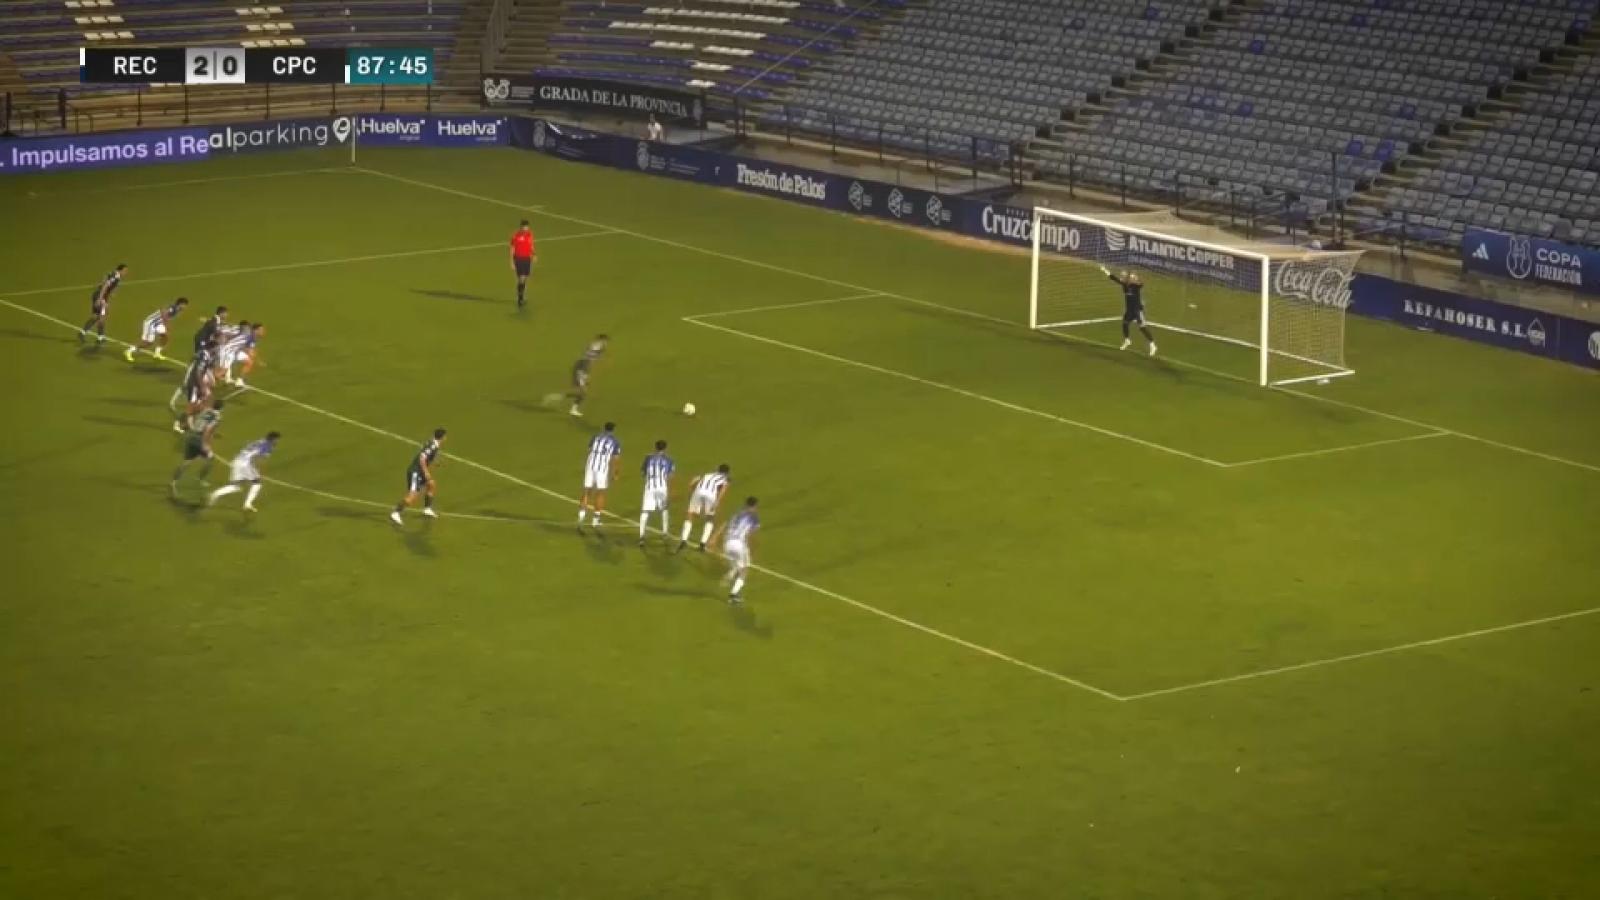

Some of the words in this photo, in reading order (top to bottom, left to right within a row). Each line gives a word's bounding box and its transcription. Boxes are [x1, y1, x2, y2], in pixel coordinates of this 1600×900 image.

[539, 85, 589, 104] GRADA
[592, 90, 613, 106] DE
[612, 92, 629, 108] LA
[630, 95, 688, 118] PROVINCIA
[361, 117, 421, 135] Huelva
[437, 118, 497, 136] Huelva
[12, 142, 148, 168] Impulsamos
[154, 137, 173, 156] al
[778, 172, 793, 194] de
[794, 174, 826, 200] Palos
[1129, 234, 1186, 260] ATLANTIC
[1186, 246, 1234, 270] COPPER
[1536, 247, 1581, 268] COPA
[1403, 299, 1496, 333] REFAHOSER
